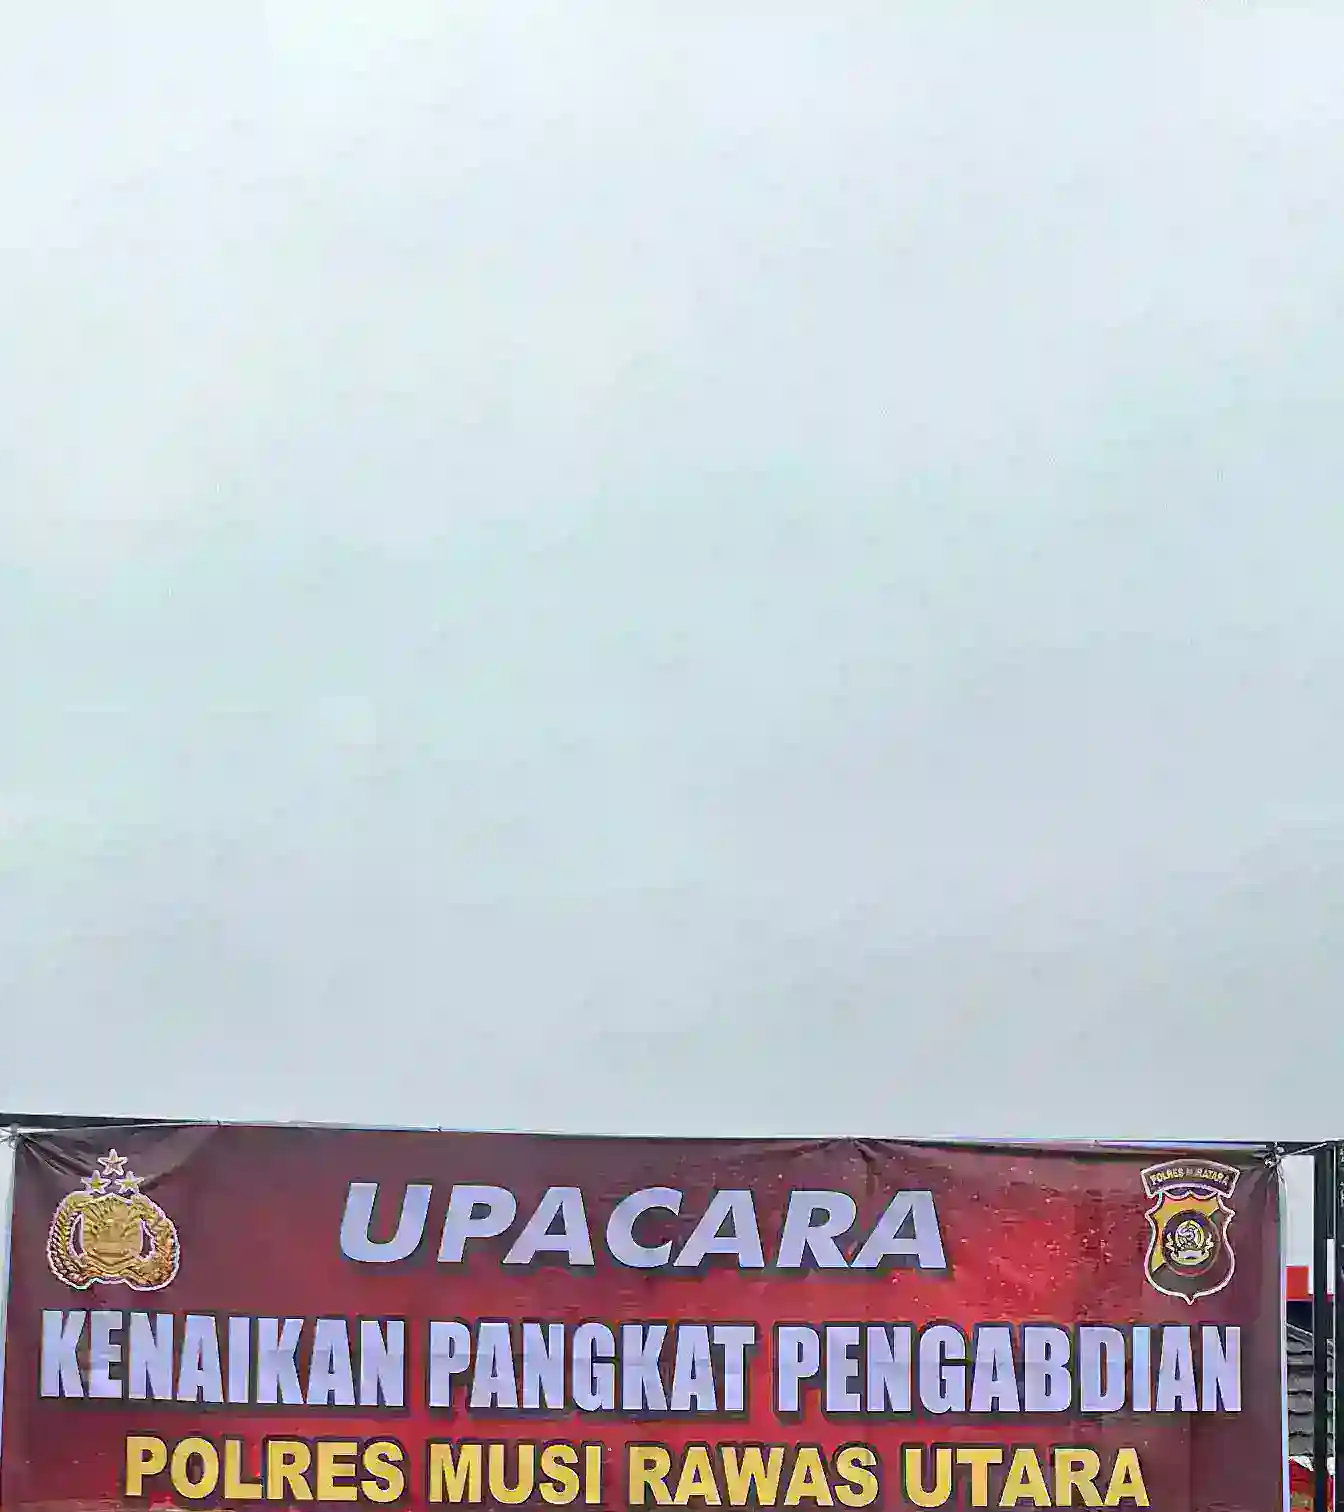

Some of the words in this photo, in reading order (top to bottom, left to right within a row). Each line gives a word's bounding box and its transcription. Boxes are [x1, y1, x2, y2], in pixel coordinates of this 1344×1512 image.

[1150, 1167, 1184, 1185] POLRES
[340, 1183, 946, 1269] UPACARA
[41, 1310, 404, 1406] KENAIKAN
[429, 1321, 754, 1411] PANGKAT
[778, 1325, 1241, 1413] PENGABDIAN
[126, 1437, 403, 1502] POLRES
[430, 1443, 600, 1504] MUSI
[630, 1446, 877, 1506] RAWAS
[906, 1448, 1149, 1507] UTARA
